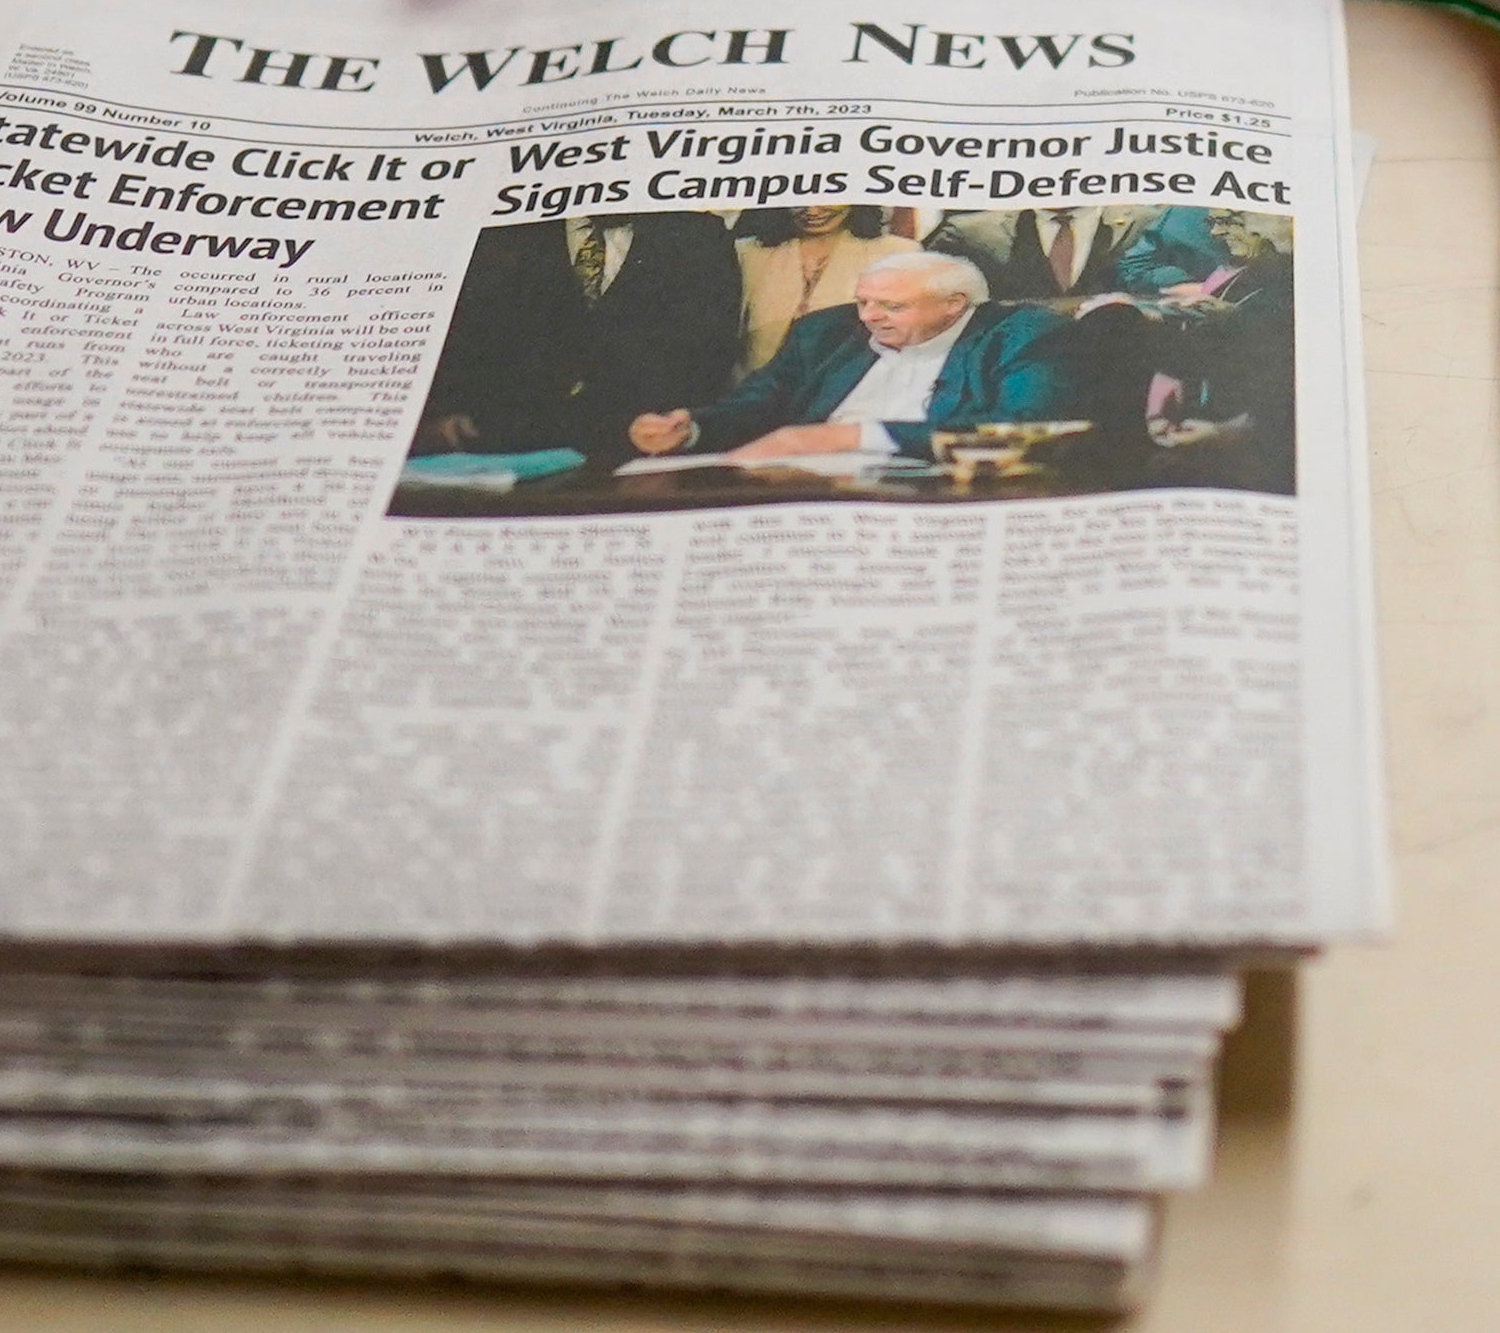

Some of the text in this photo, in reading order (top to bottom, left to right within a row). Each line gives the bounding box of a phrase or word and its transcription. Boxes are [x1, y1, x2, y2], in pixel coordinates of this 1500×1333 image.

[170, 22, 1137, 95] THE WELCH NEWS
[522, 87, 767, 115] Continuing The Welch Daily News
[1074, 88, 1146, 98] Publication
[1150, 88, 1172, 96] No.
[1178, 91, 1217, 101] USPS
[74, 102, 97, 114] 99
[103, 108, 182, 128] Number
[190, 120, 211, 131] 10
[415, 104, 873, 144] Welch, West Virginia, Tuesday, March 7th, 2023
[1166, 107, 1271, 128] Price $1.25
[508, 124, 1274, 174] West Virginia Governor Justice
[231, 146, 356, 183] Click
[367, 152, 408, 183] It
[420, 153, 477, 181] or
[107, 174, 445, 222] Enforcement
[491, 164, 1292, 218] Signs Campus Self-Defense Act
[44, 208, 316, 269] Underway
[67, 258, 100, 271] WV
[130, 265, 163, 277] The
[180, 270, 256, 282] occurred
[273, 274, 289, 283] in
[307, 275, 349, 284] rural
[75, 287, 150, 303] Program
[169, 295, 217, 307] urban
[174, 283, 444, 300] compared to 36 percent in
[0, 293, 111, 314] coordinating
[22, 310, 36, 321] It
[50, 314, 68, 323] or
[83, 314, 139, 327] Ticket
[181, 309, 436, 323] Law enforcement officers
[21, 325, 133, 340] enforcement
[156, 321, 431, 336] across West Virginia will be out
[150, 334, 168, 343] in
[173, 335, 203, 346] full
[267, 339, 343, 351] ticketing
[351, 338, 427, 349] violators
